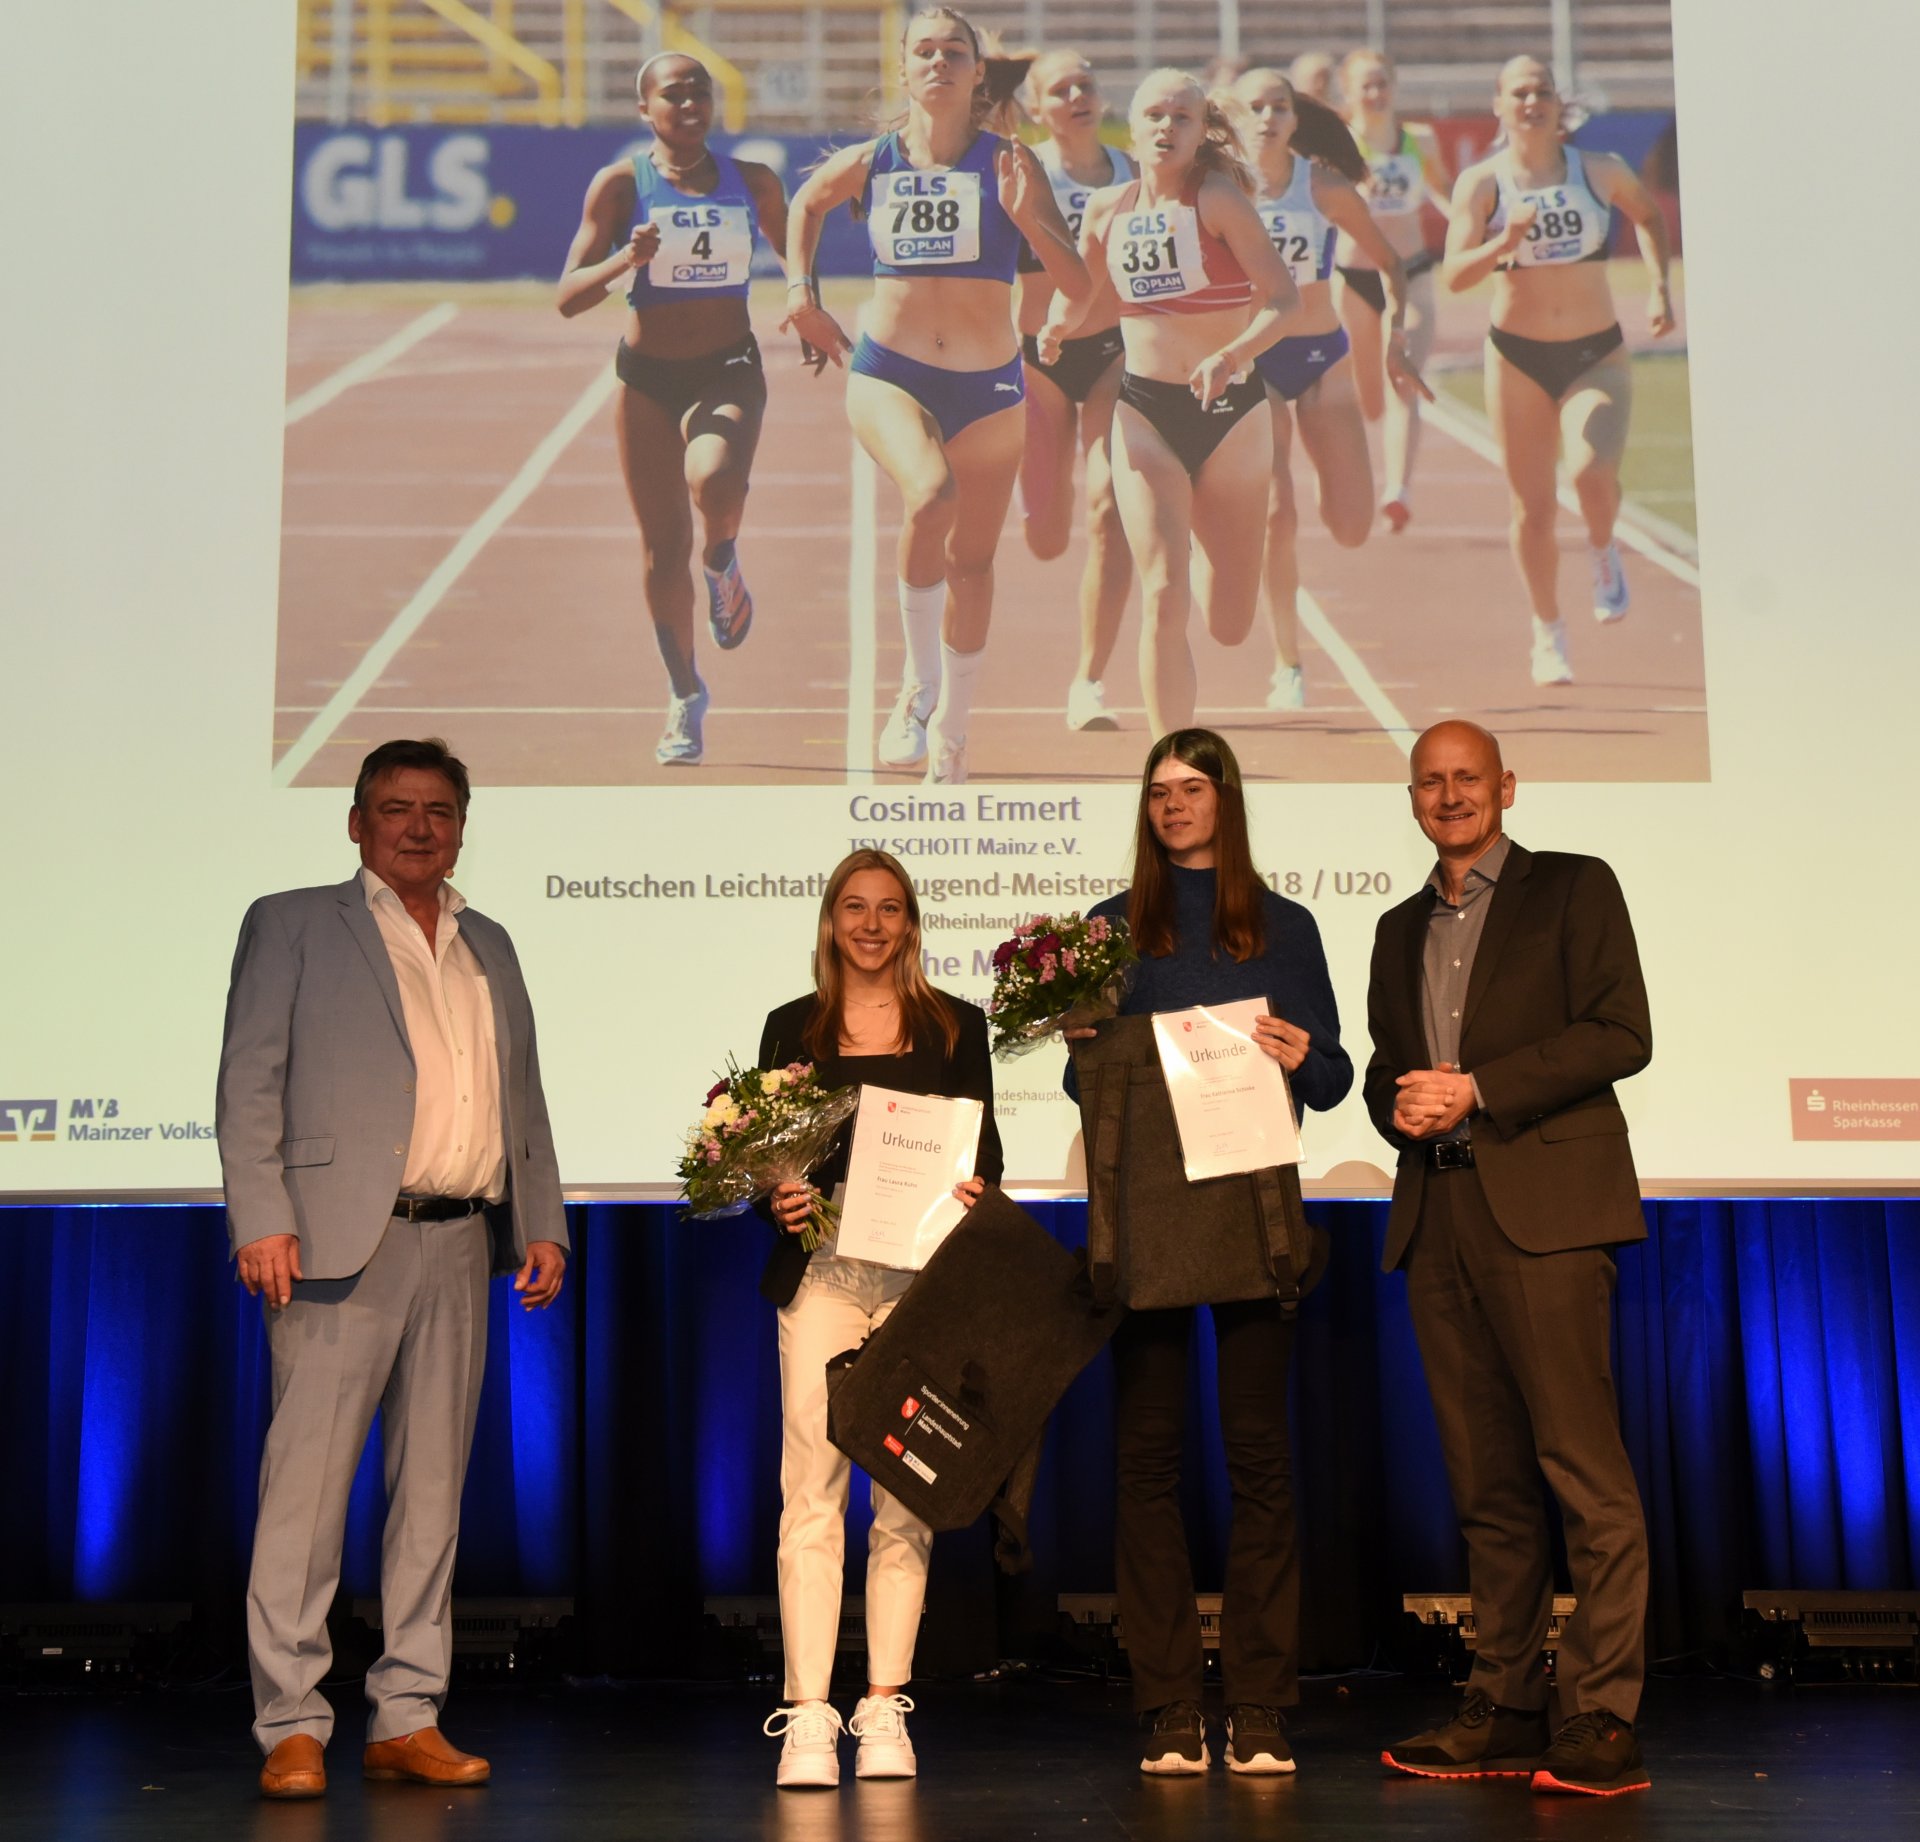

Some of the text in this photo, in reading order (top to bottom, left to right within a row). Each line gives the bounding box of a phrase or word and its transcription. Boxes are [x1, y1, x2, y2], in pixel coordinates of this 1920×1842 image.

[889, 200, 960, 233] 788
[691, 231, 712, 260] 4
[917, 240, 951, 250] PLAN
[1122, 236, 1178, 273] 331
[1271, 235, 1309, 262] 72
[849, 795, 1082, 822] Cosima Ermert
[891, 838, 971, 855] SCHOTT
[977, 838, 1038, 855] Mainz
[1043, 838, 1082, 855] e.V.
[546, 874, 695, 898] Deutschen
[704, 873, 830, 897] Leichtath
[912, 872, 1133, 901] ugend-Meisters
[1259, 871, 1302, 895] 18
[1335, 872, 1391, 895] U20
[1189, 1043, 1248, 1064] Urkunde
[994, 1090, 1072, 1102] ndeshaupts
[1832, 1100, 1919, 1112] Rheinhessen
[994, 1105, 1017, 1116] ainz
[68, 1124, 152, 1141] Mainzer
[1832, 1116, 1902, 1129] Sparkasse
[882, 1131, 942, 1154] Urkunde
